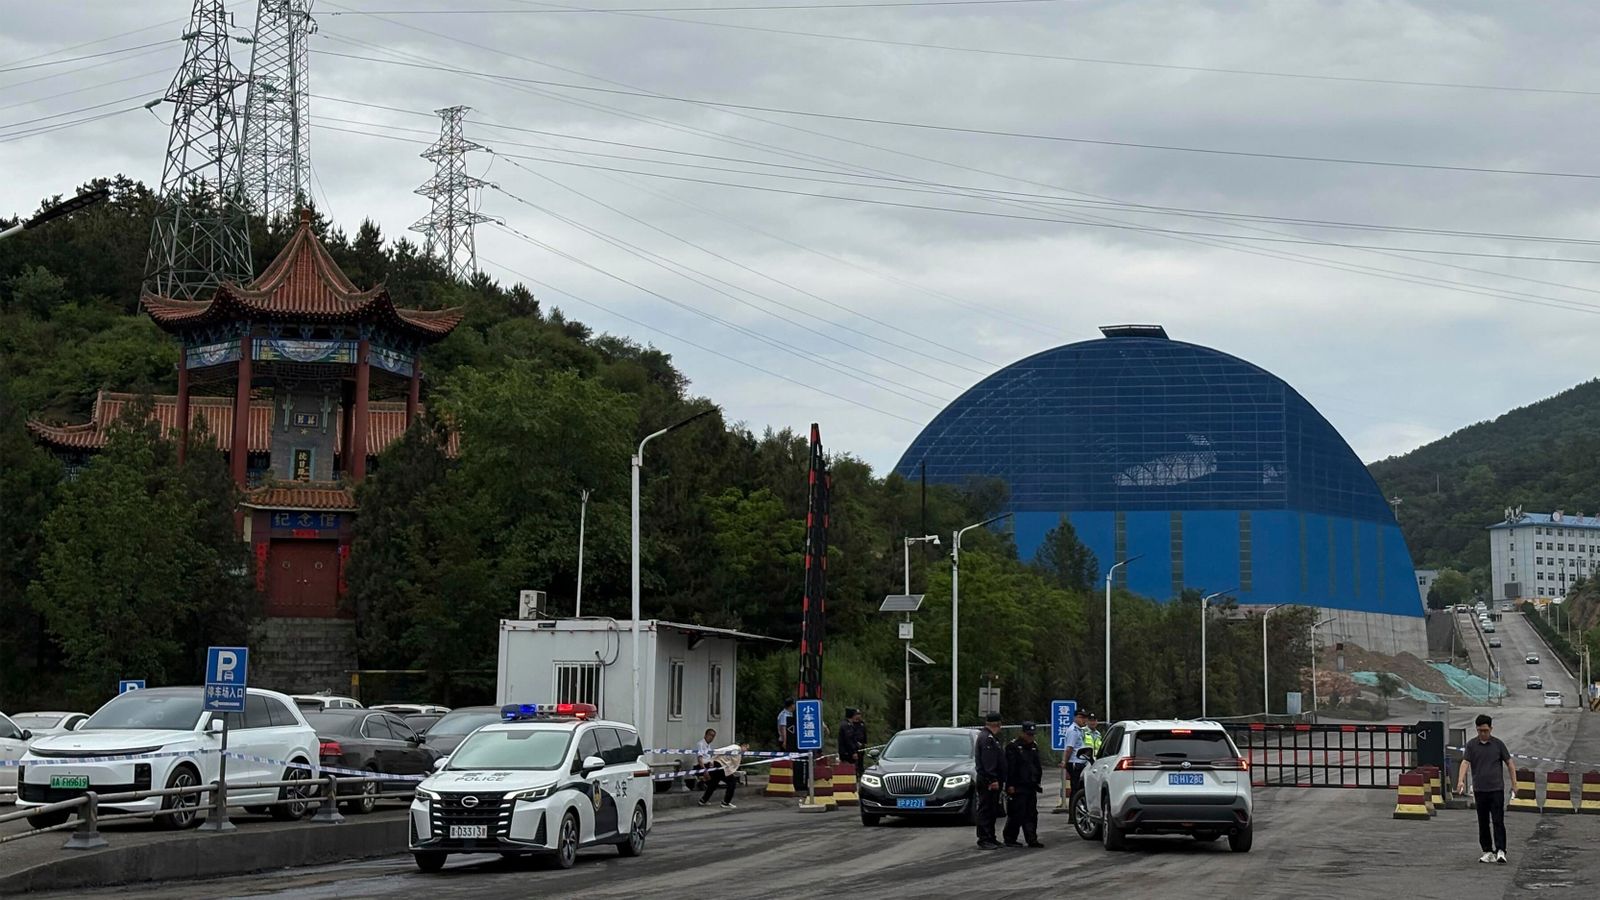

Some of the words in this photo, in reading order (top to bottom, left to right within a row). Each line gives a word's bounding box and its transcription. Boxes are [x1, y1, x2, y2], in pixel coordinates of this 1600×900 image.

[274, 512, 337, 528] 纪念馆
[216, 650, 237, 682] P
[207, 686, 243, 698] 停车场入口
[802, 705, 815, 738] 小车通道
[615, 778, 628, 798] 公安
